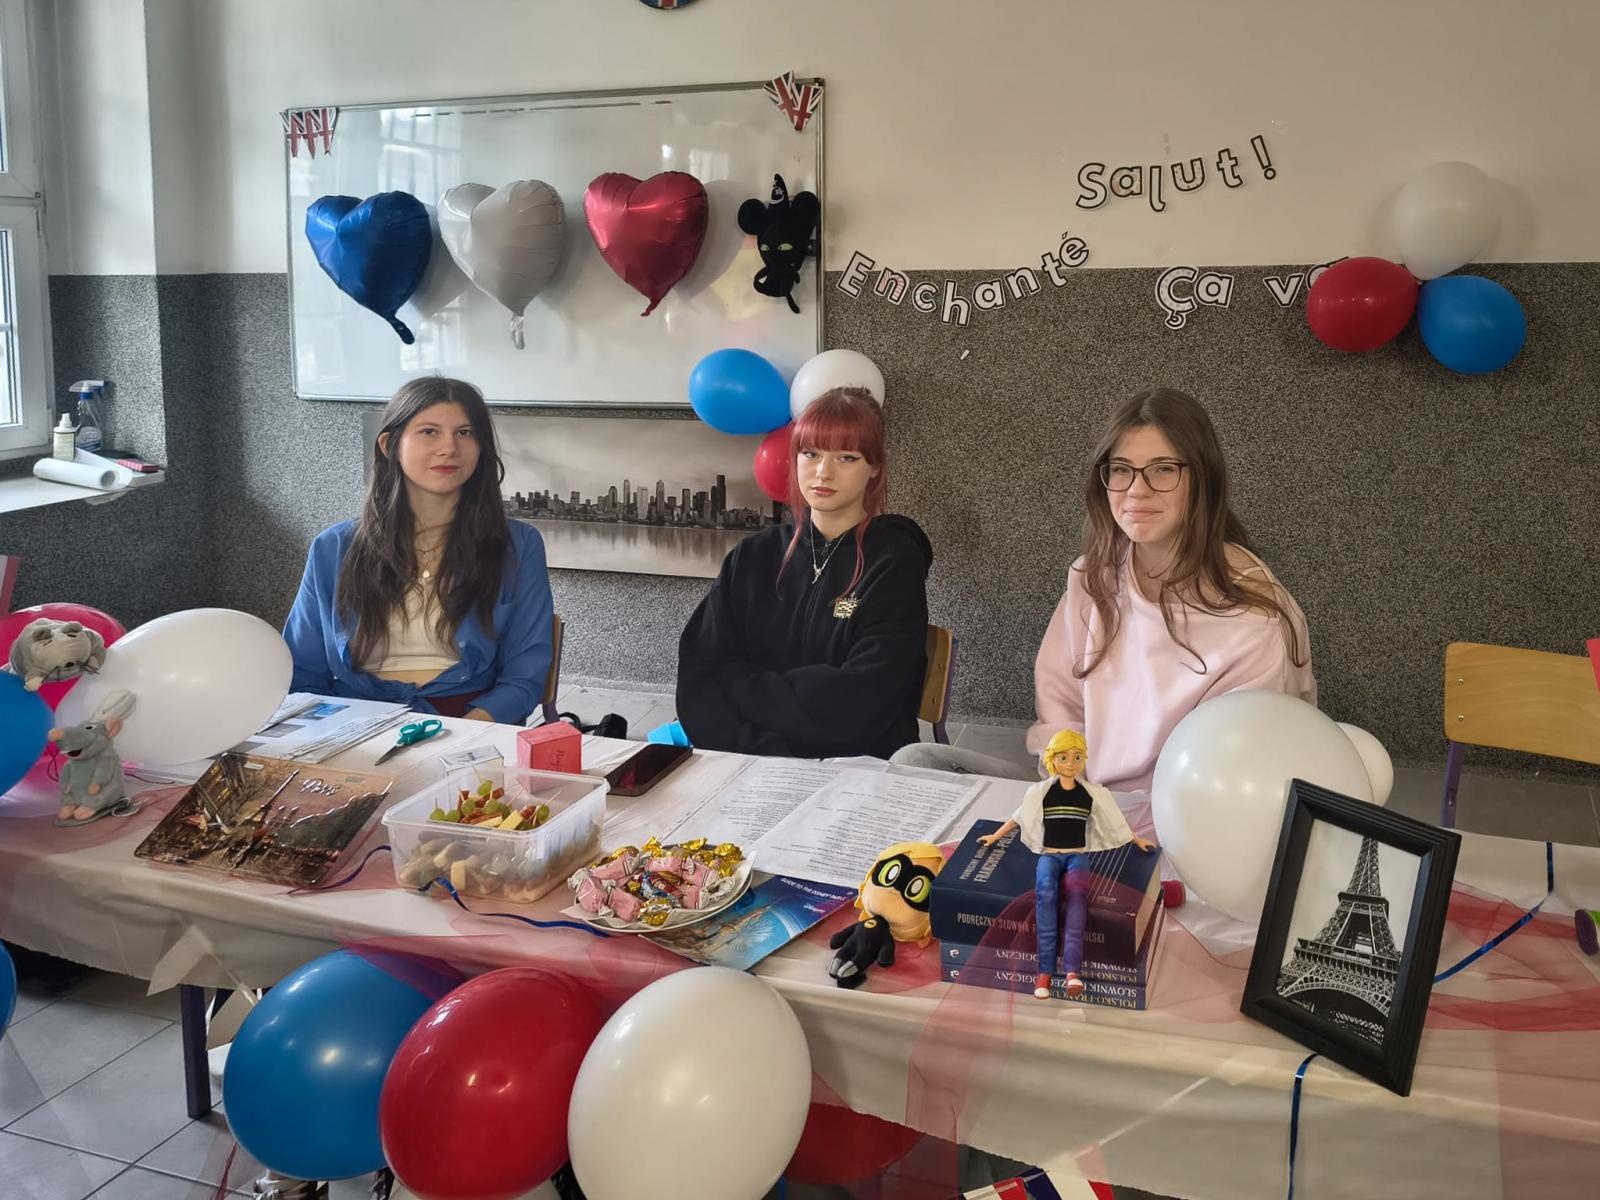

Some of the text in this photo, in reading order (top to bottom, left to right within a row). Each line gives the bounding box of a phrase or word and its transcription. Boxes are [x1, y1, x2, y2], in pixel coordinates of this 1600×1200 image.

[836, 231, 1089, 326] Enchanté
[1155, 266, 1234, 329] Ça
[1088, 980, 1137, 997] SŁOWNIK
